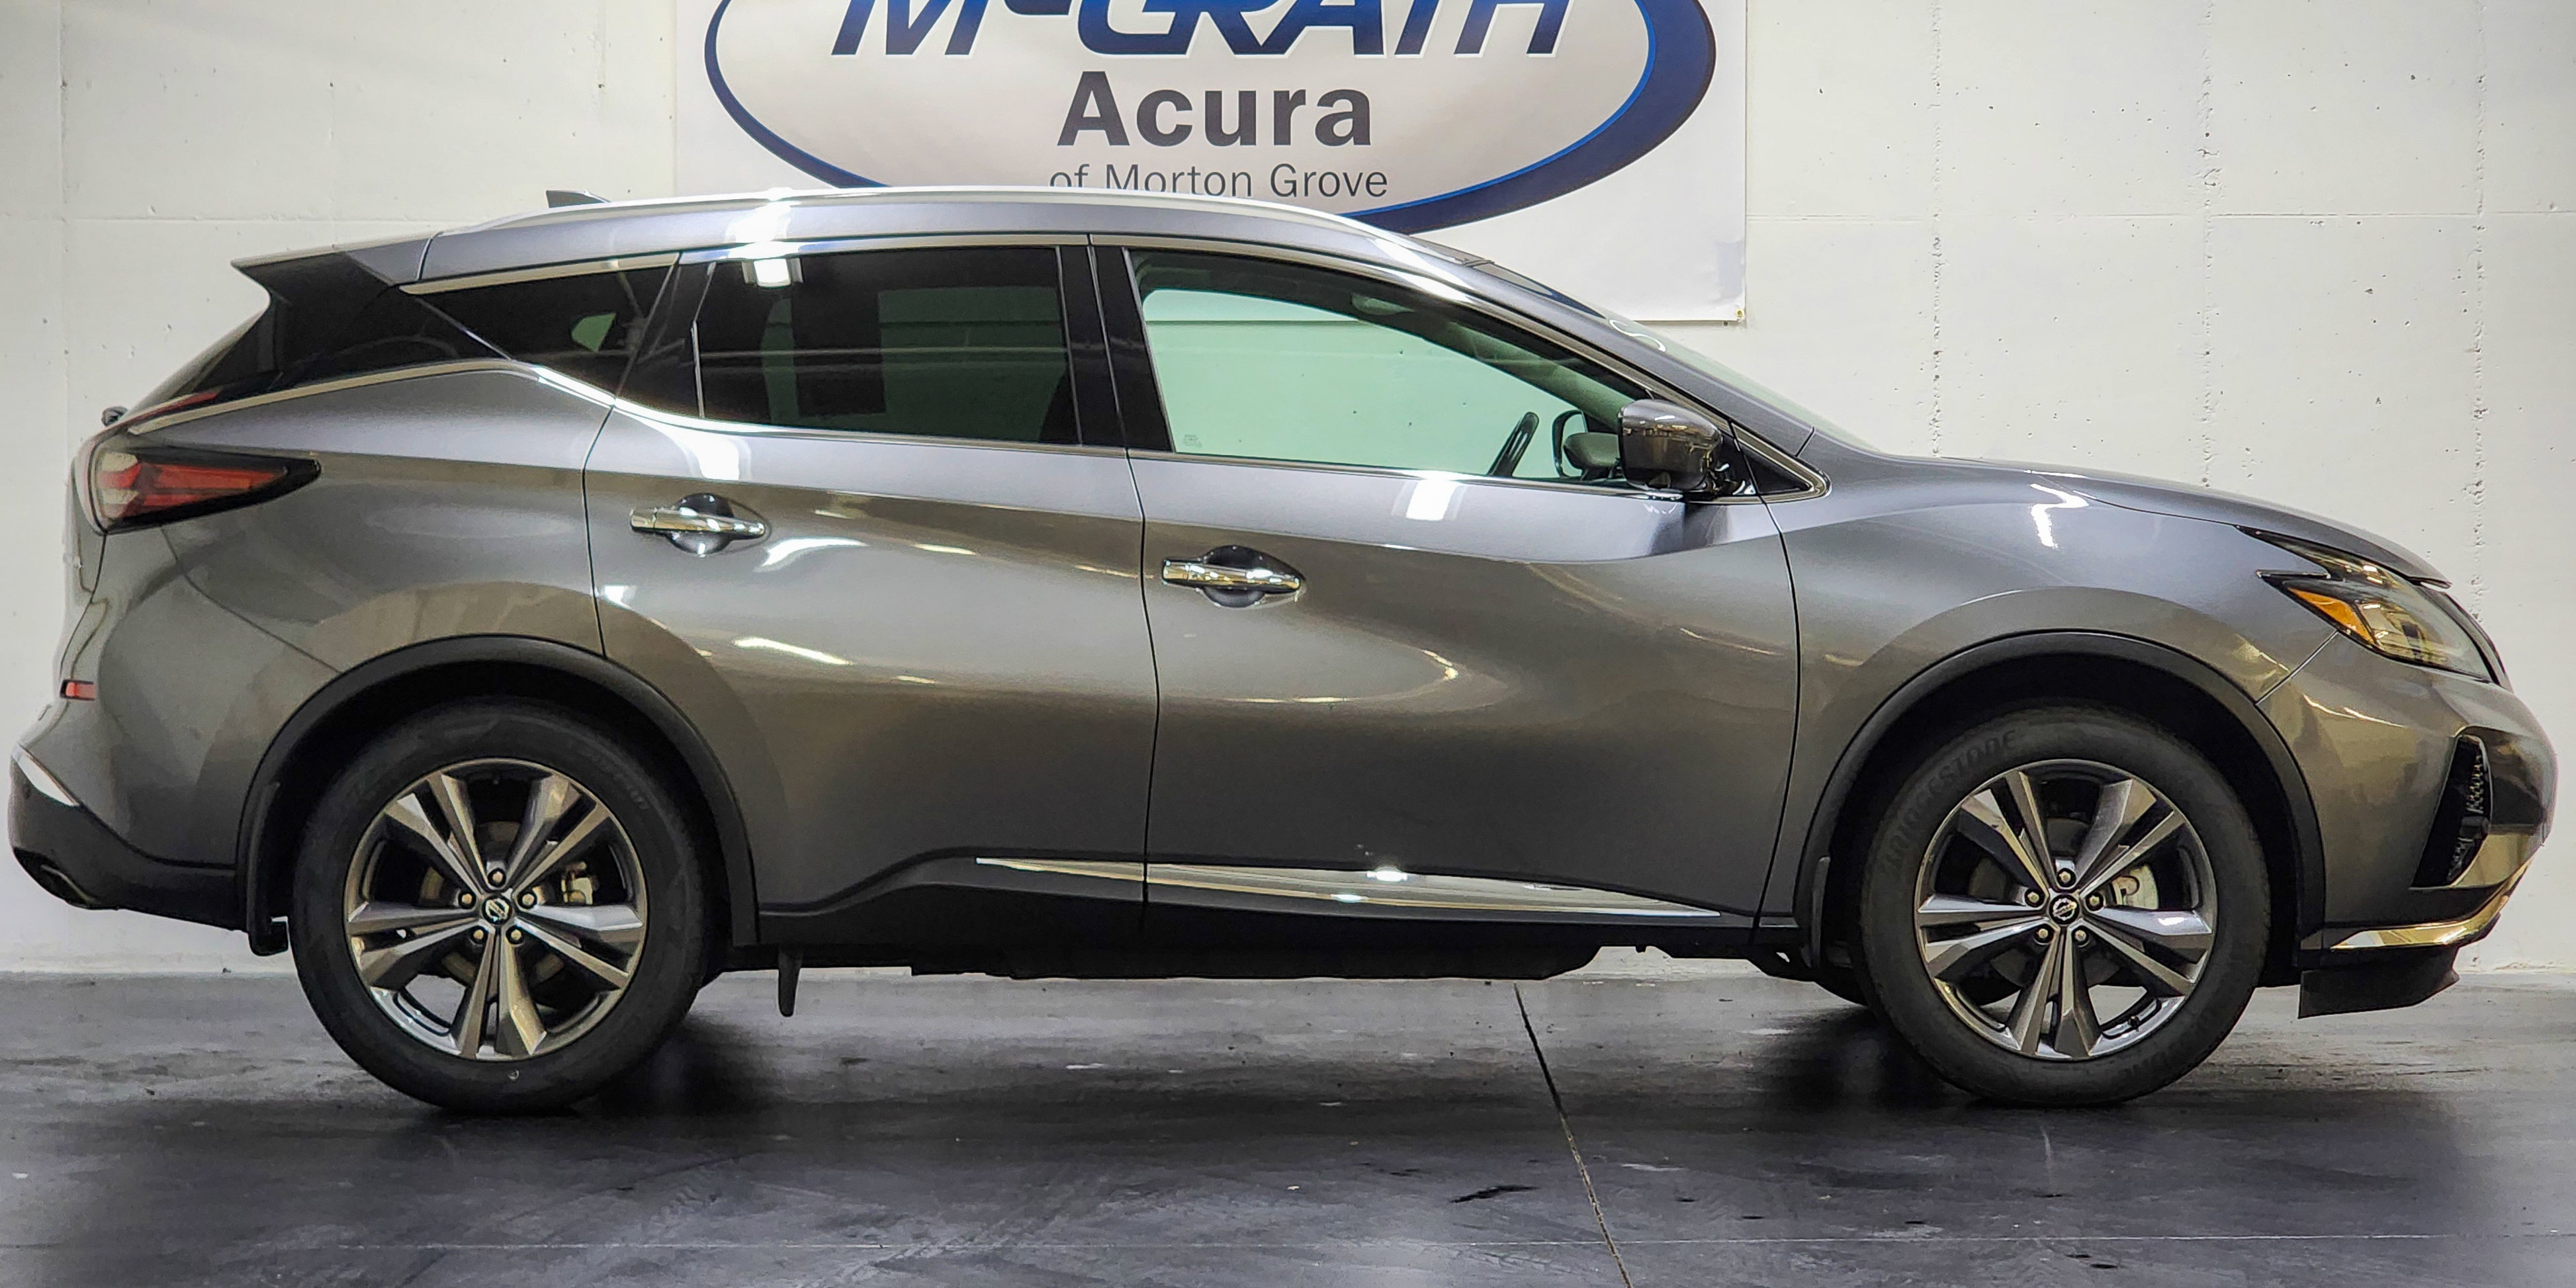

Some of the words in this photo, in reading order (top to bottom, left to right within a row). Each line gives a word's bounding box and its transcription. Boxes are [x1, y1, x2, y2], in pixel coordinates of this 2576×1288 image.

[831, 0, 1569, 56] MGRAH
[1057, 71, 1371, 146] Acura
[1050, 163, 1089, 187] of
[1106, 163, 1251, 196] Morton
[1270, 163, 1388, 197] Grove
